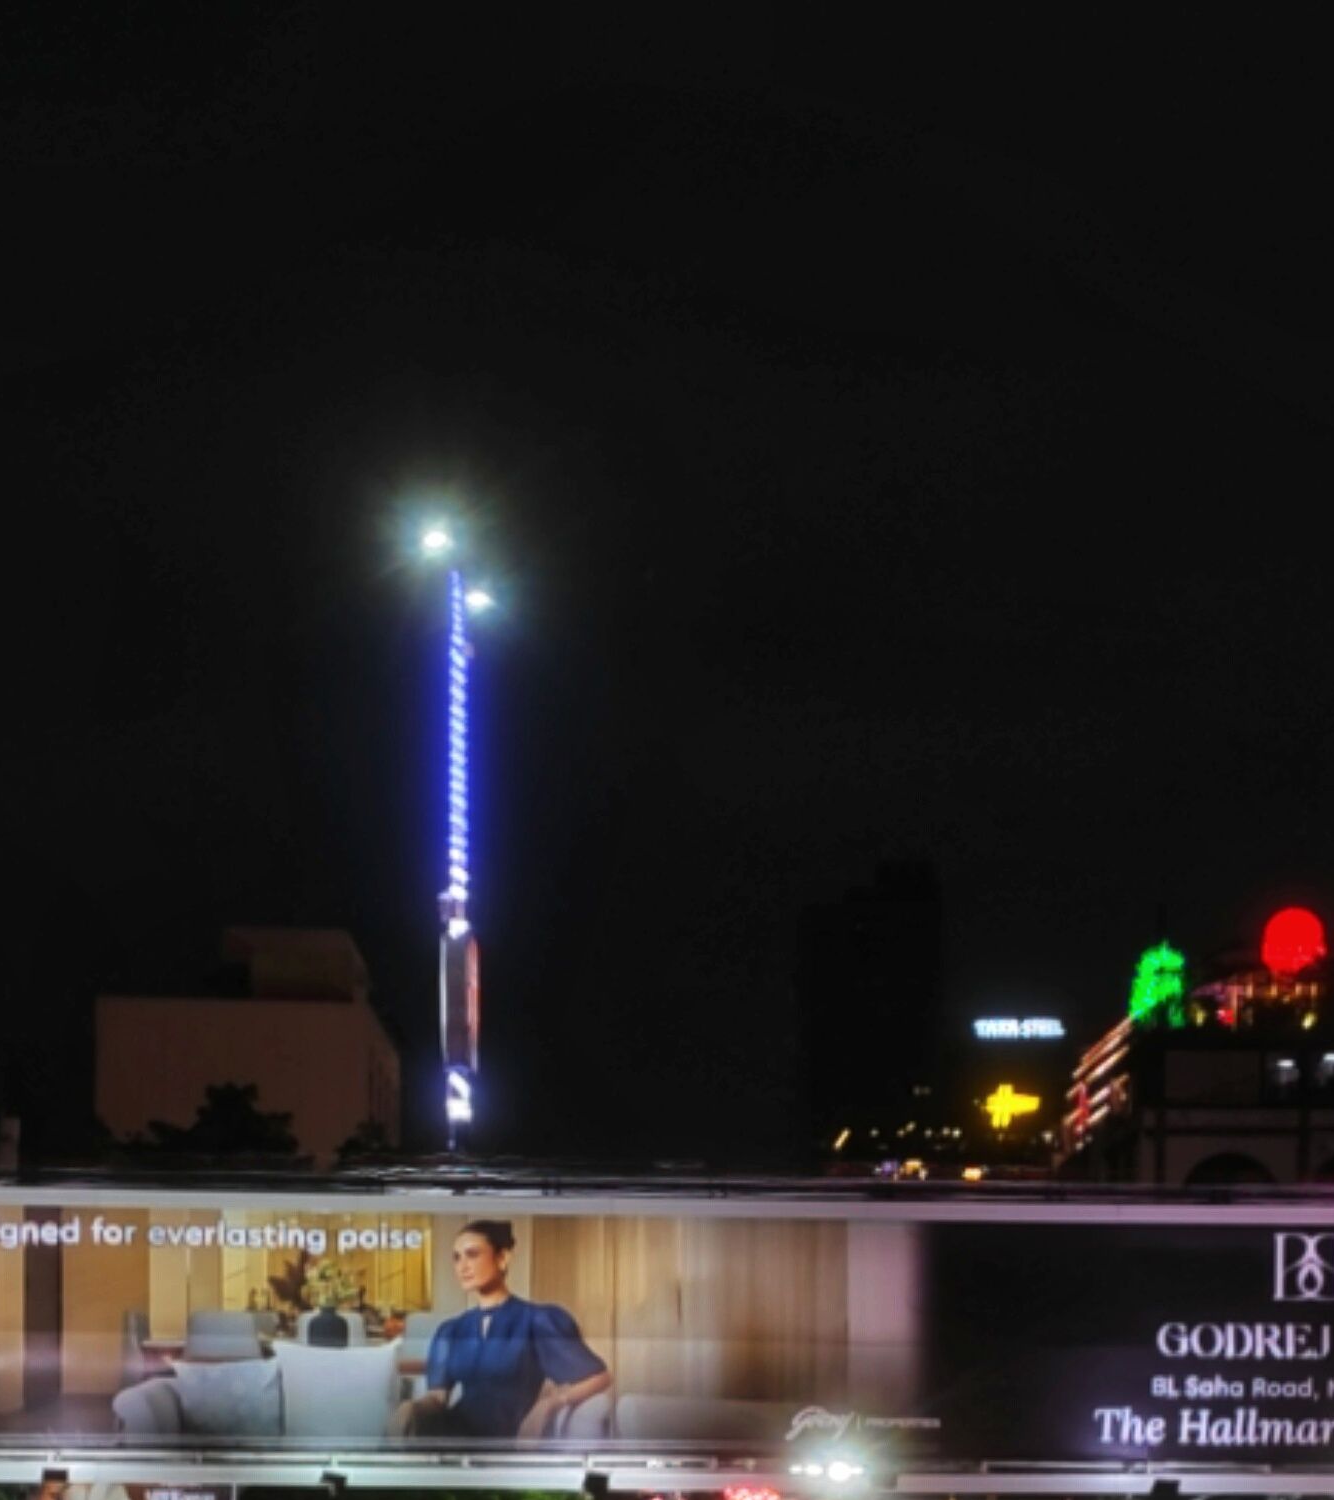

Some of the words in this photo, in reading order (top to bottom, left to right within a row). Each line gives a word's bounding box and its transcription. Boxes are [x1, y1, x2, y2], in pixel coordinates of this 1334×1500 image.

[91, 1215, 138, 1246] for
[148, 1218, 327, 1256] everlasting
[337, 1221, 424, 1256] poise
[1156, 1321, 1331, 1361] GODREJ
[1150, 1377, 1180, 1398] BL
[1183, 1375, 1245, 1399] Saha
[1251, 1377, 1319, 1403] Road,
[1093, 1406, 1166, 1446] The
